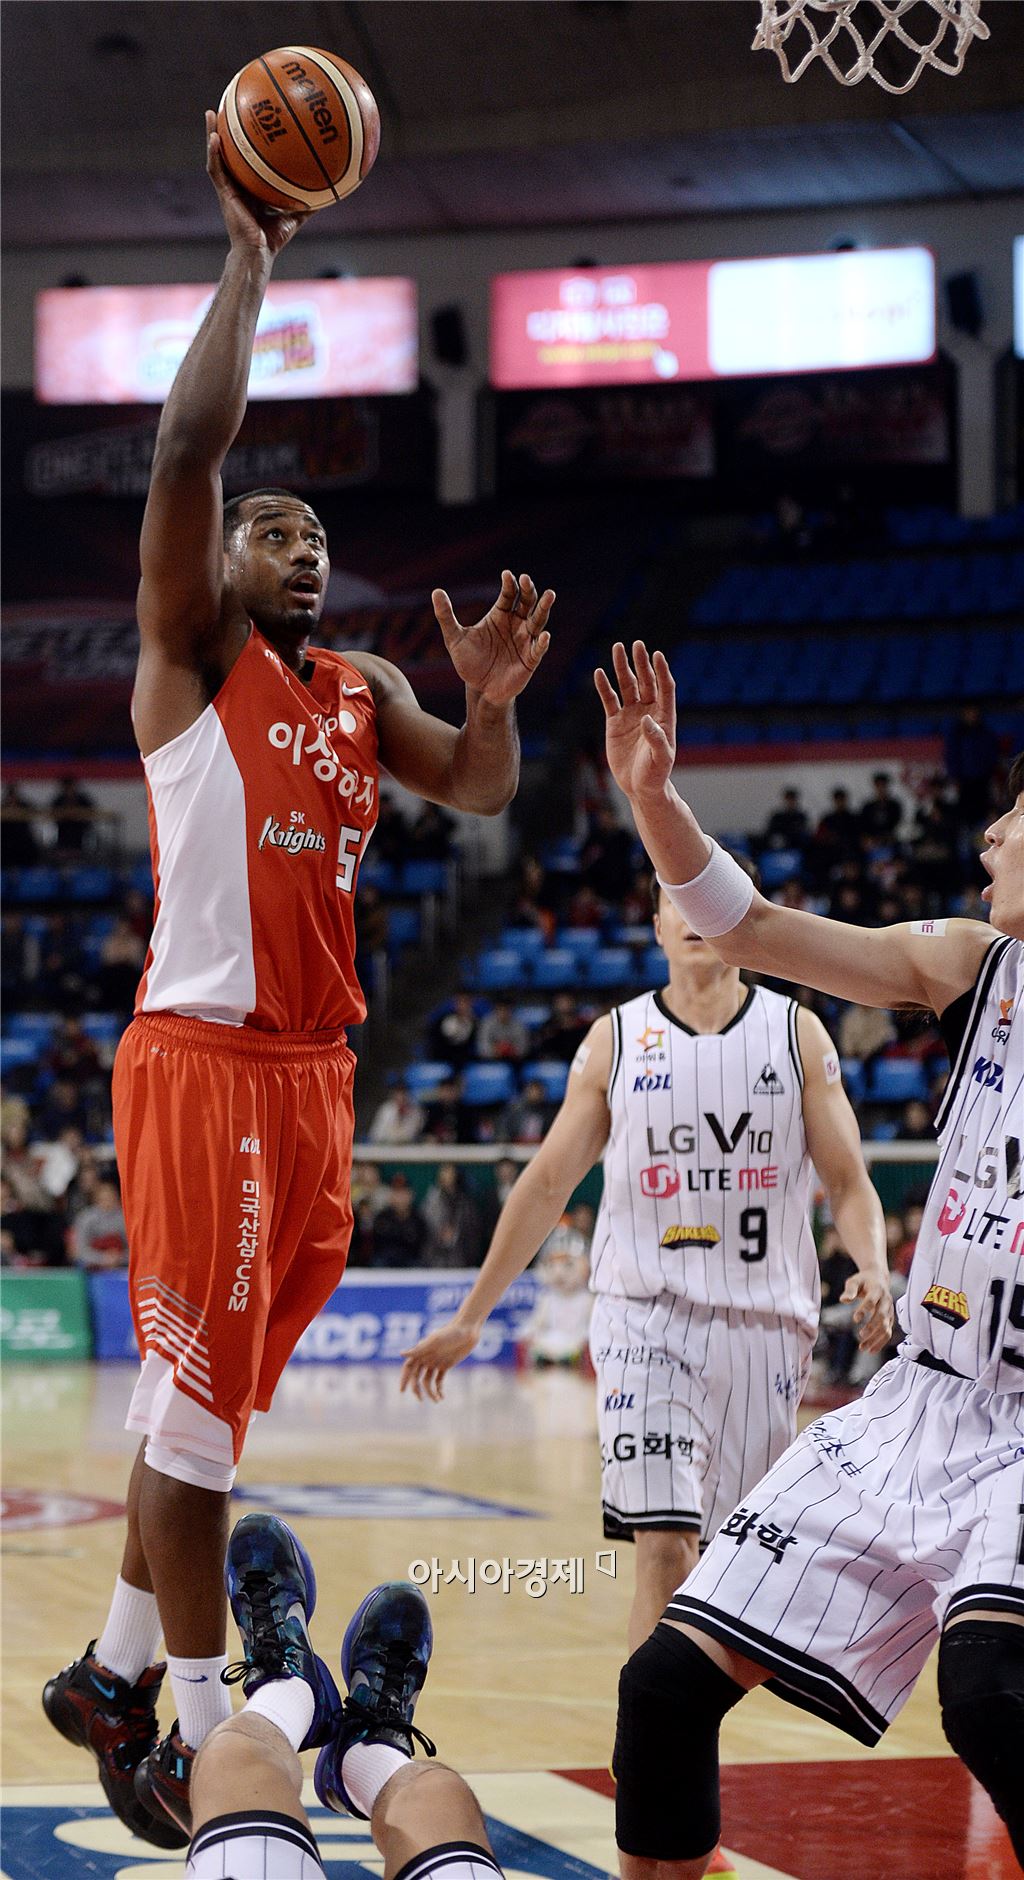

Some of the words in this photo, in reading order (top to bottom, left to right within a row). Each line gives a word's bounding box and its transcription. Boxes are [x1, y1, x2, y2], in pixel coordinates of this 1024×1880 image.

[281, 61, 339, 145] molten
[258, 815, 326, 855] Knights
[289, 810, 306, 825] SK
[633, 1069, 672, 1092] KBL
[647, 1125, 696, 1157] LG
[703, 1112, 773, 1155] V10
[687, 1169, 732, 1193] LTE
[738, 1166, 779, 1192] ME
[227, 1179, 261, 1313] 미국산삼.COM
[739, 1206, 768, 1264] 9
[718, 1507, 799, 1565] 화학
